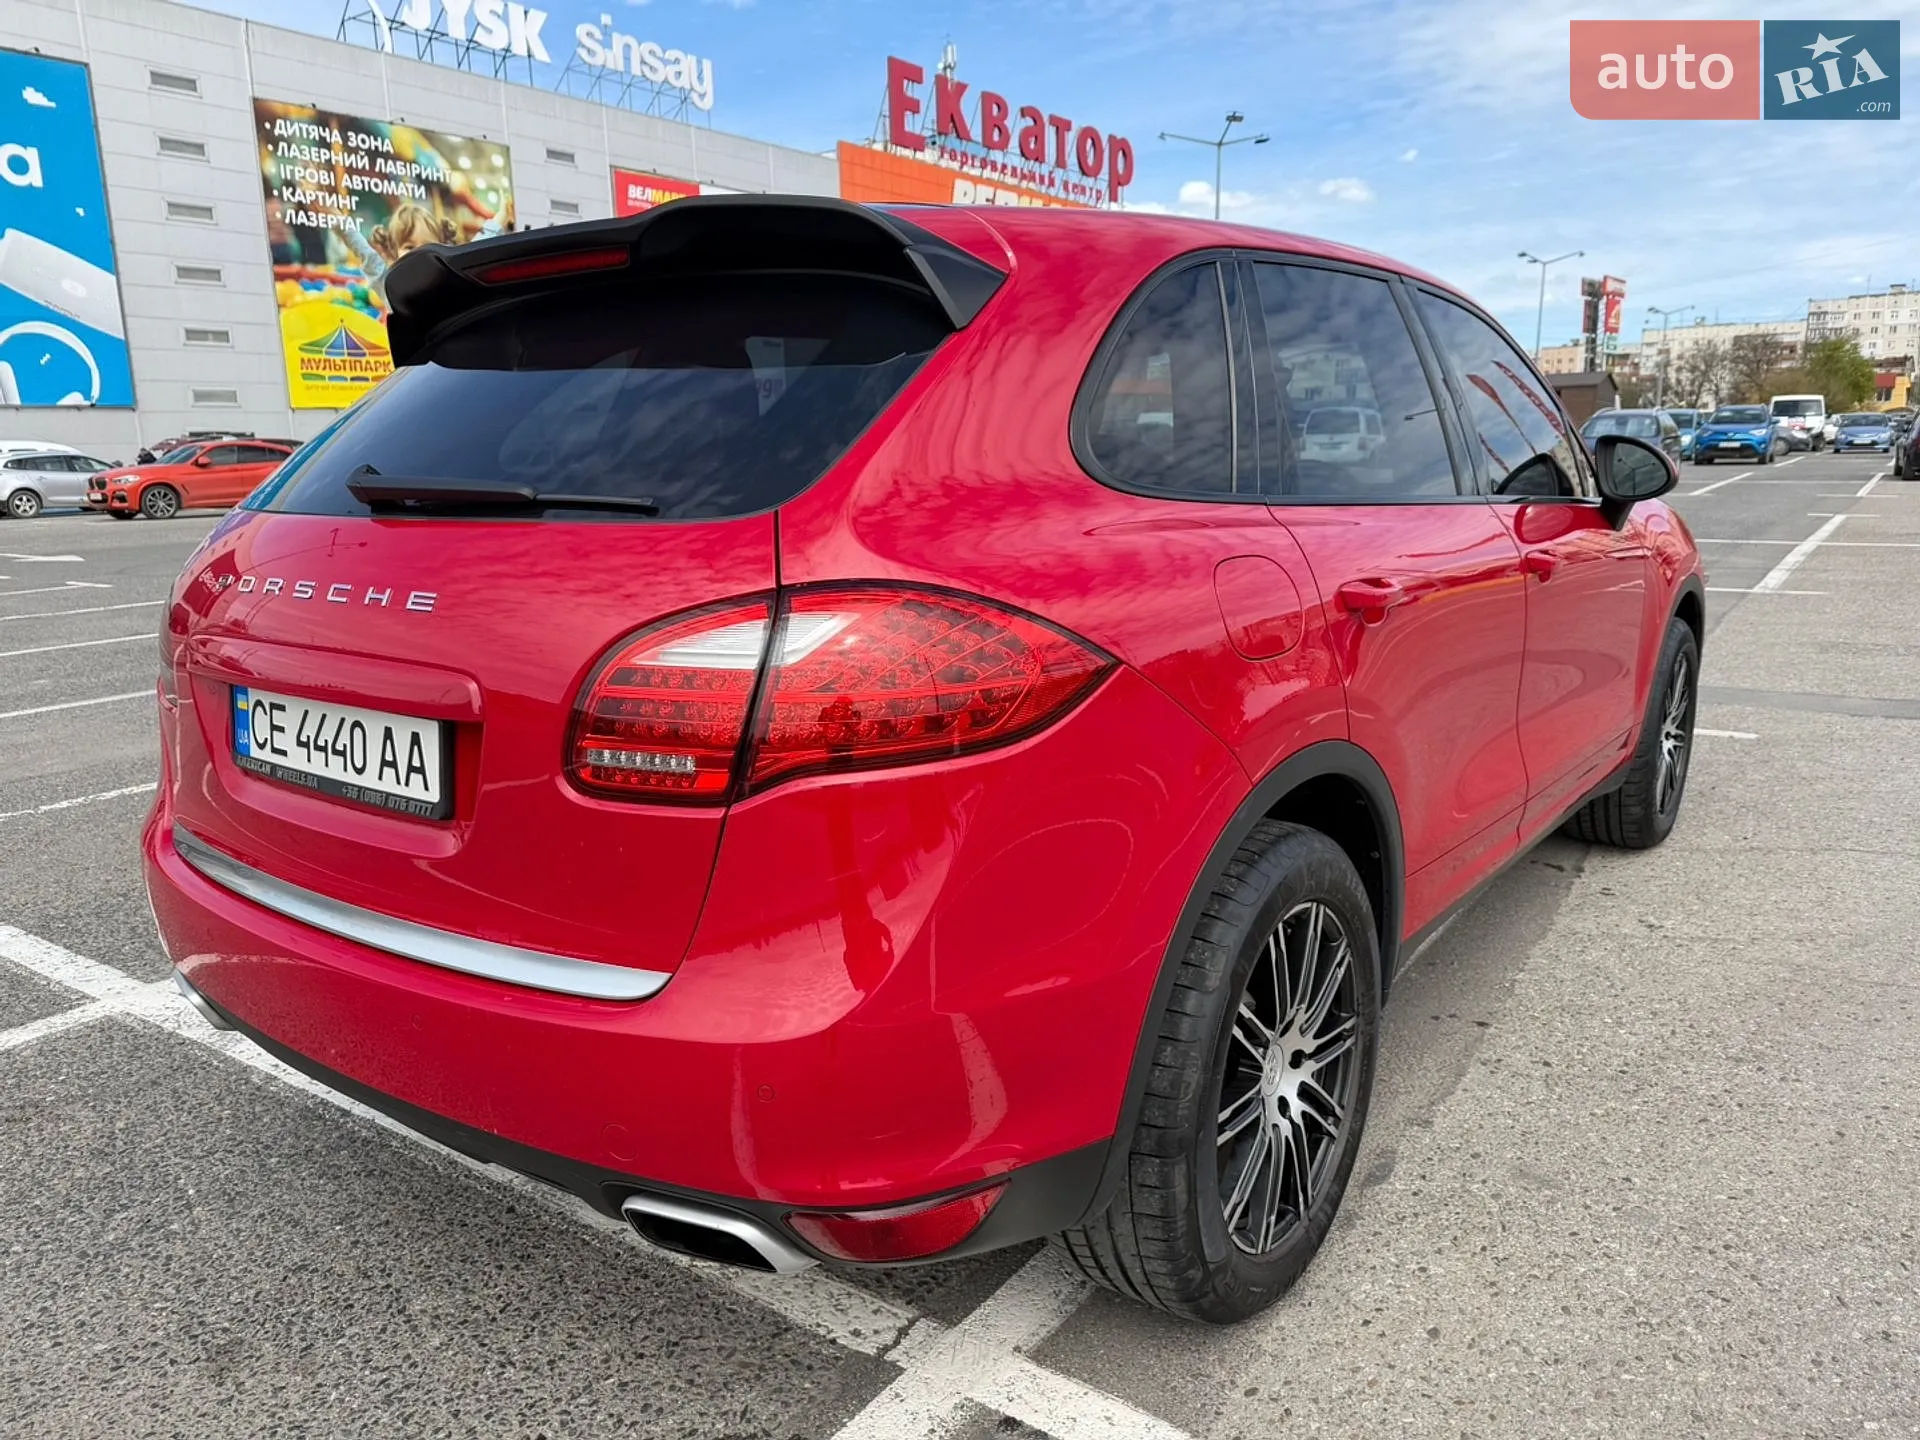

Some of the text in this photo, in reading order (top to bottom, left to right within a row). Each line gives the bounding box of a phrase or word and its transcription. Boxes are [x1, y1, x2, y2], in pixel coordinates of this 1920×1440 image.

[402, 0, 552, 63] JYSK
[575, 14, 714, 111] sinsay
[274, 119, 395, 155] ДИТЯЧА ЗОНА
[277, 141, 453, 184] ЛАЗЕРНИЙ ЛАБІРИНТ
[939, 146, 1057, 189] торговельний
[280, 164, 427, 200] ІГРОВІ АВТОМАТИ
[282, 186, 360, 211] КАРТИНГ
[627, 184, 688, 204] ВЕЛМА
[285, 210, 364, 233] ЛАЗЕРТАГ
[300, 357, 392, 373] МУЛЬТІПАРК
[219, 574, 438, 613] PORSCHE
[250, 699, 430, 792] CE 4440 AA
